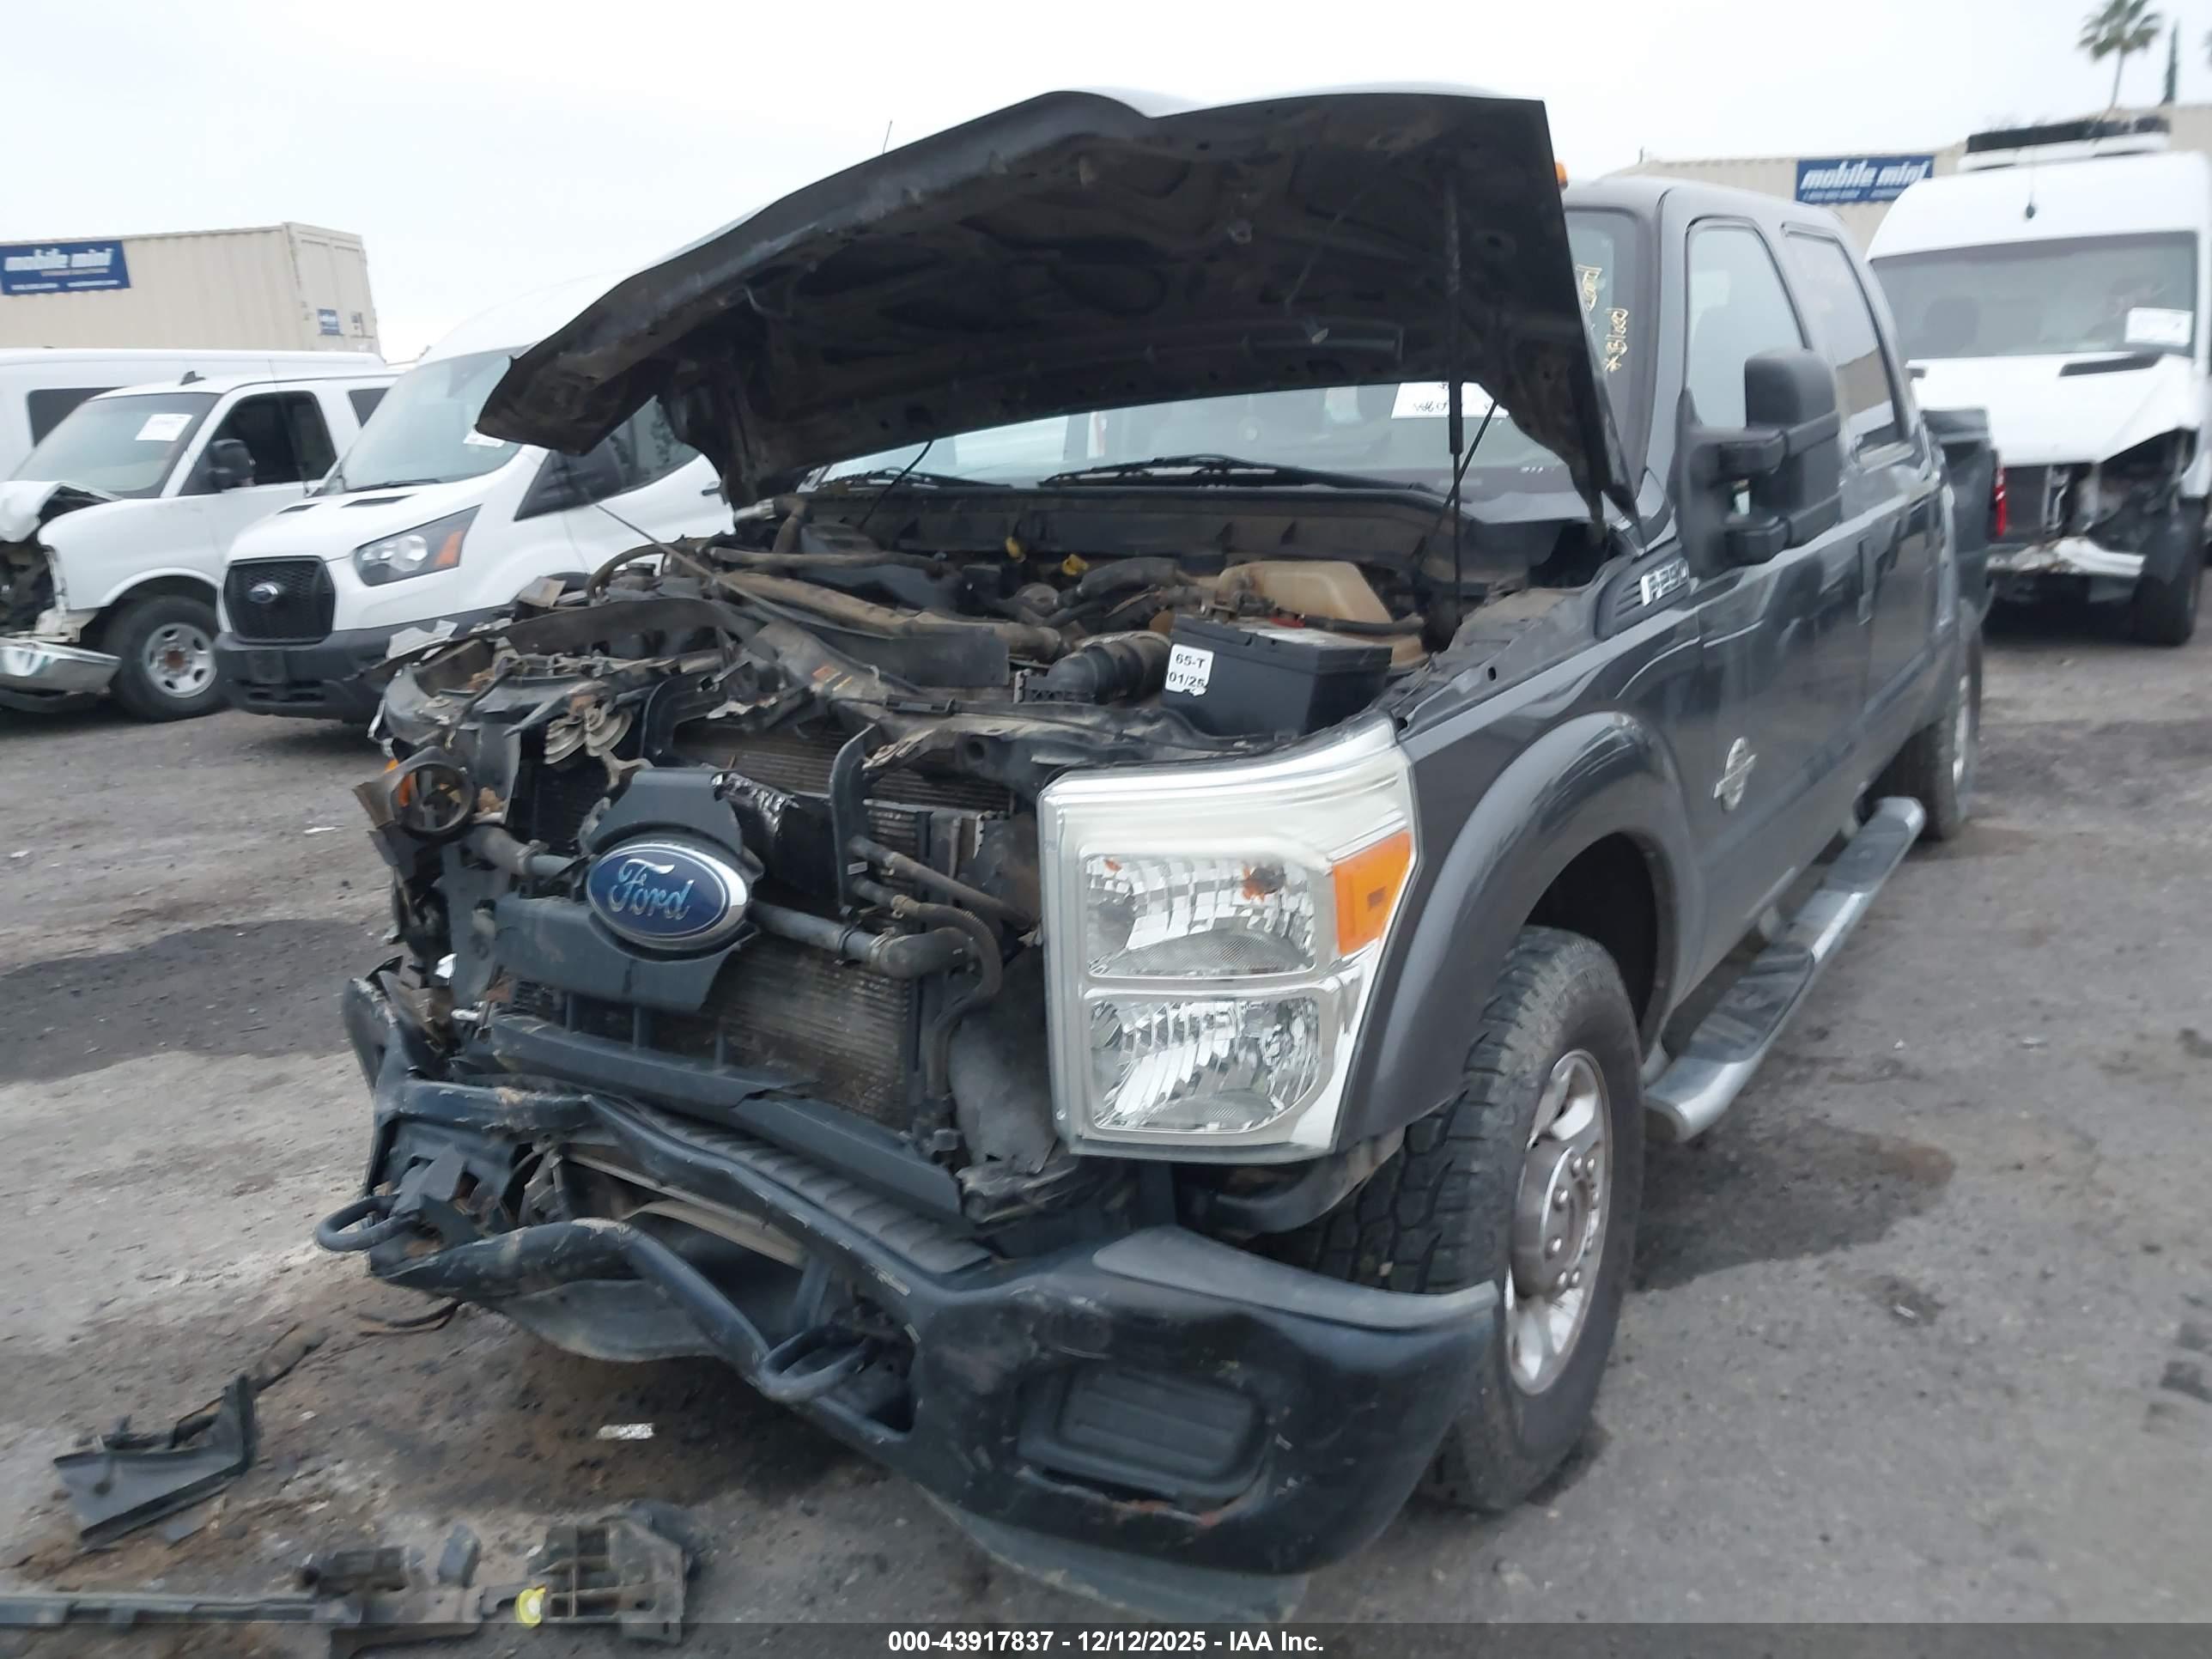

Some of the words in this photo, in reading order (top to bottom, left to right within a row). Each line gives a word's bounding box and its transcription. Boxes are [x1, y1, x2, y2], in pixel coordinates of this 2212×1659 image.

[1800, 158, 1879, 190] mobile
[1875, 160, 1931, 186] mini
[1176, 653, 1206, 669] 65-T
[1169, 672, 1206, 689] 01/25
[608, 858, 696, 921] Ford
